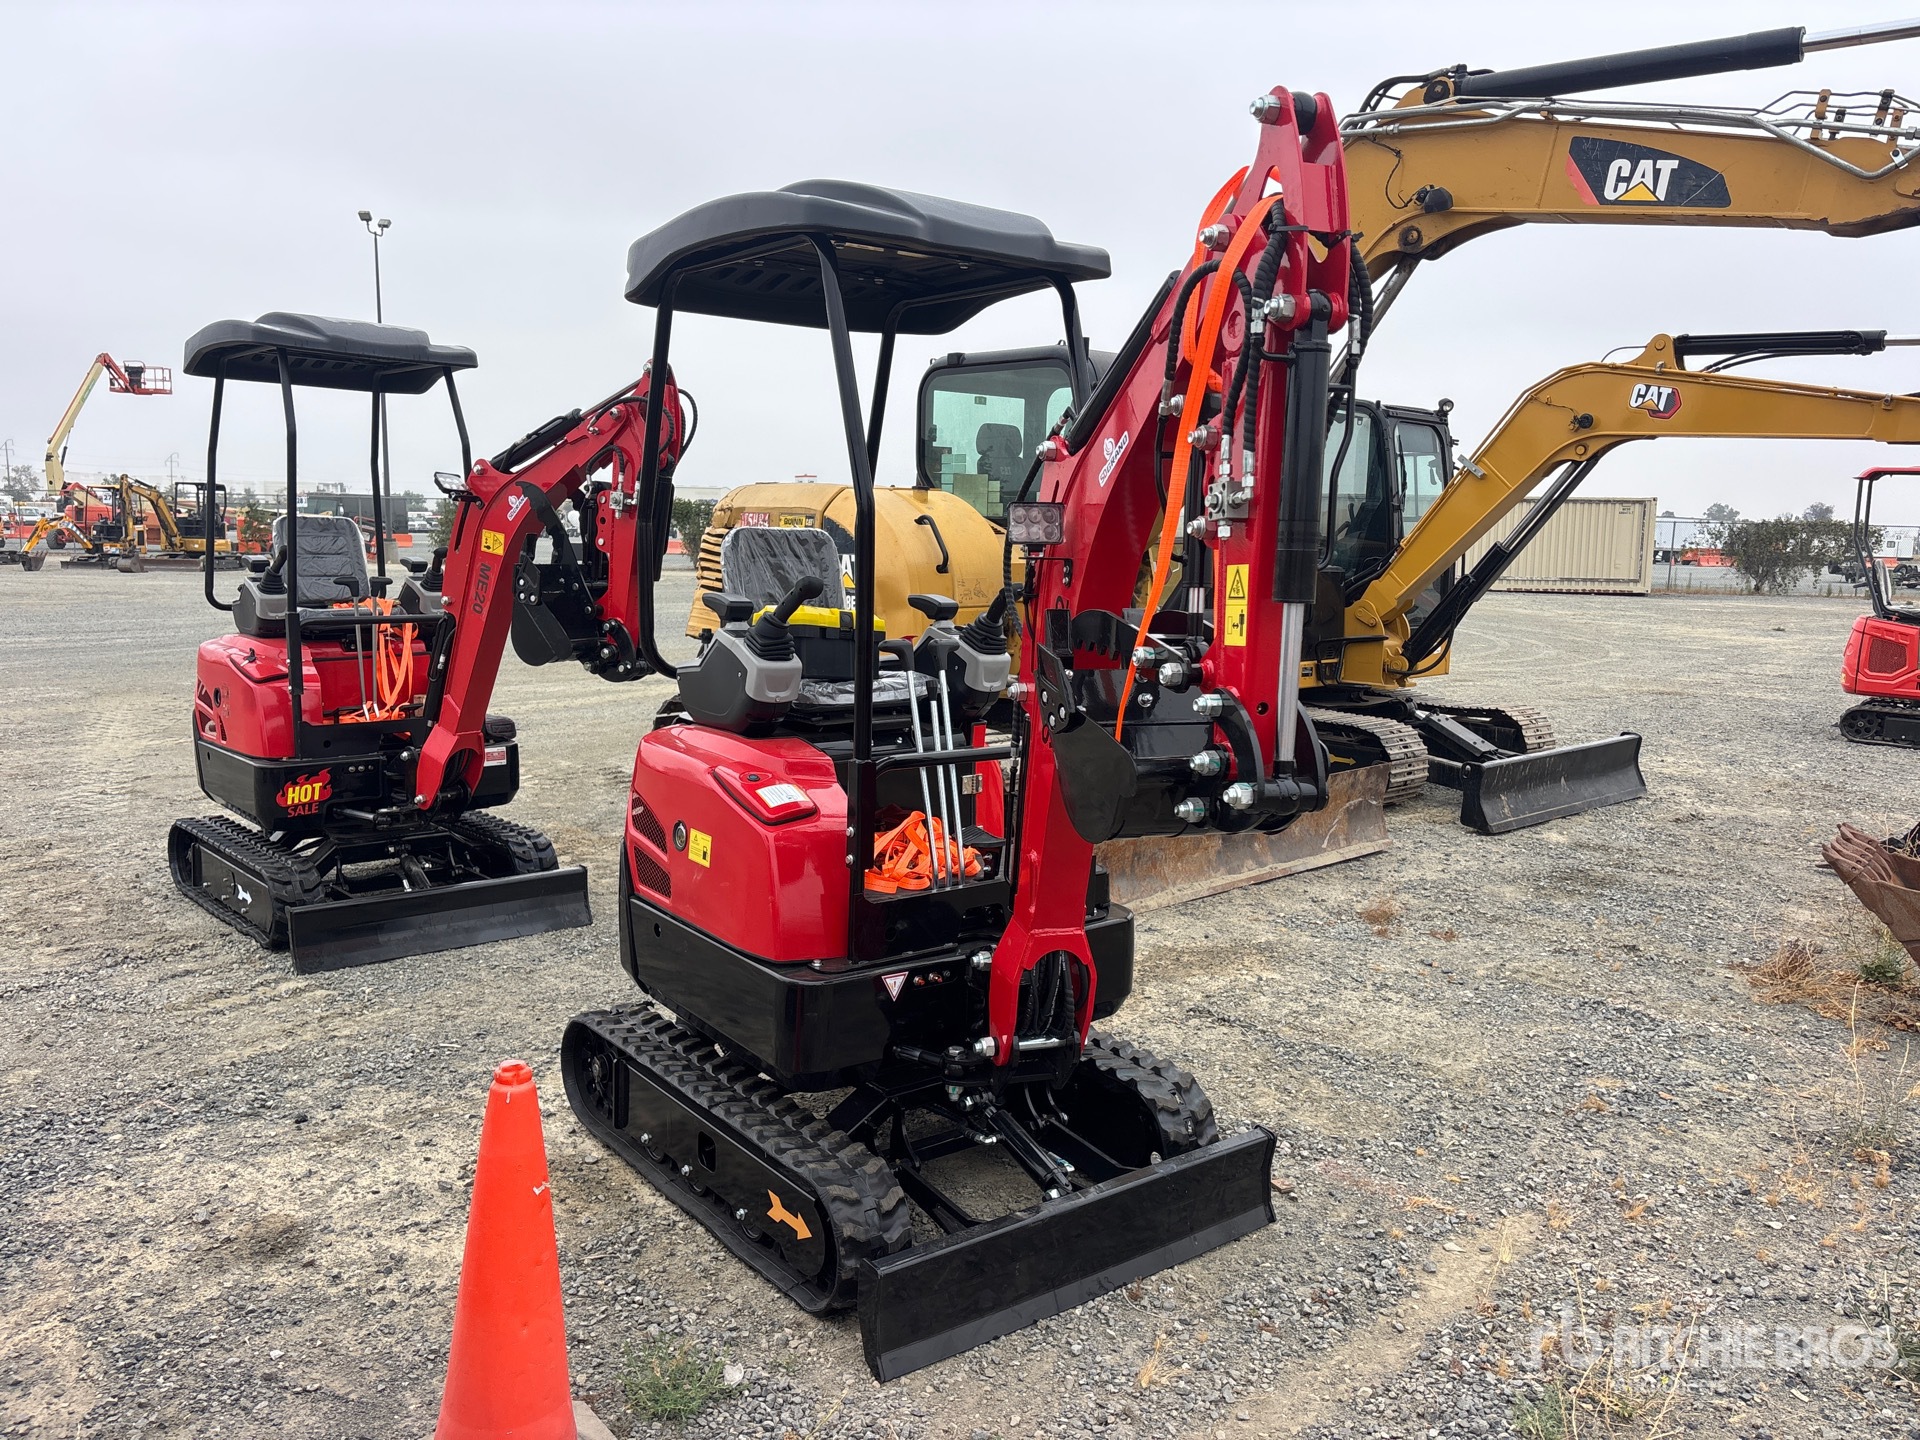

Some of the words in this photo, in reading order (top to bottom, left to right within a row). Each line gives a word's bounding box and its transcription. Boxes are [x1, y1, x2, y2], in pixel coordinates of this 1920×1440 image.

[1604, 158, 1679, 201] CAT
[1630, 383, 1673, 411] CAT
[509, 497, 525, 519] SDGRAN
[472, 562, 492, 615] ME20
[287, 782, 323, 805] HOT
[287, 802, 319, 818] SALE
